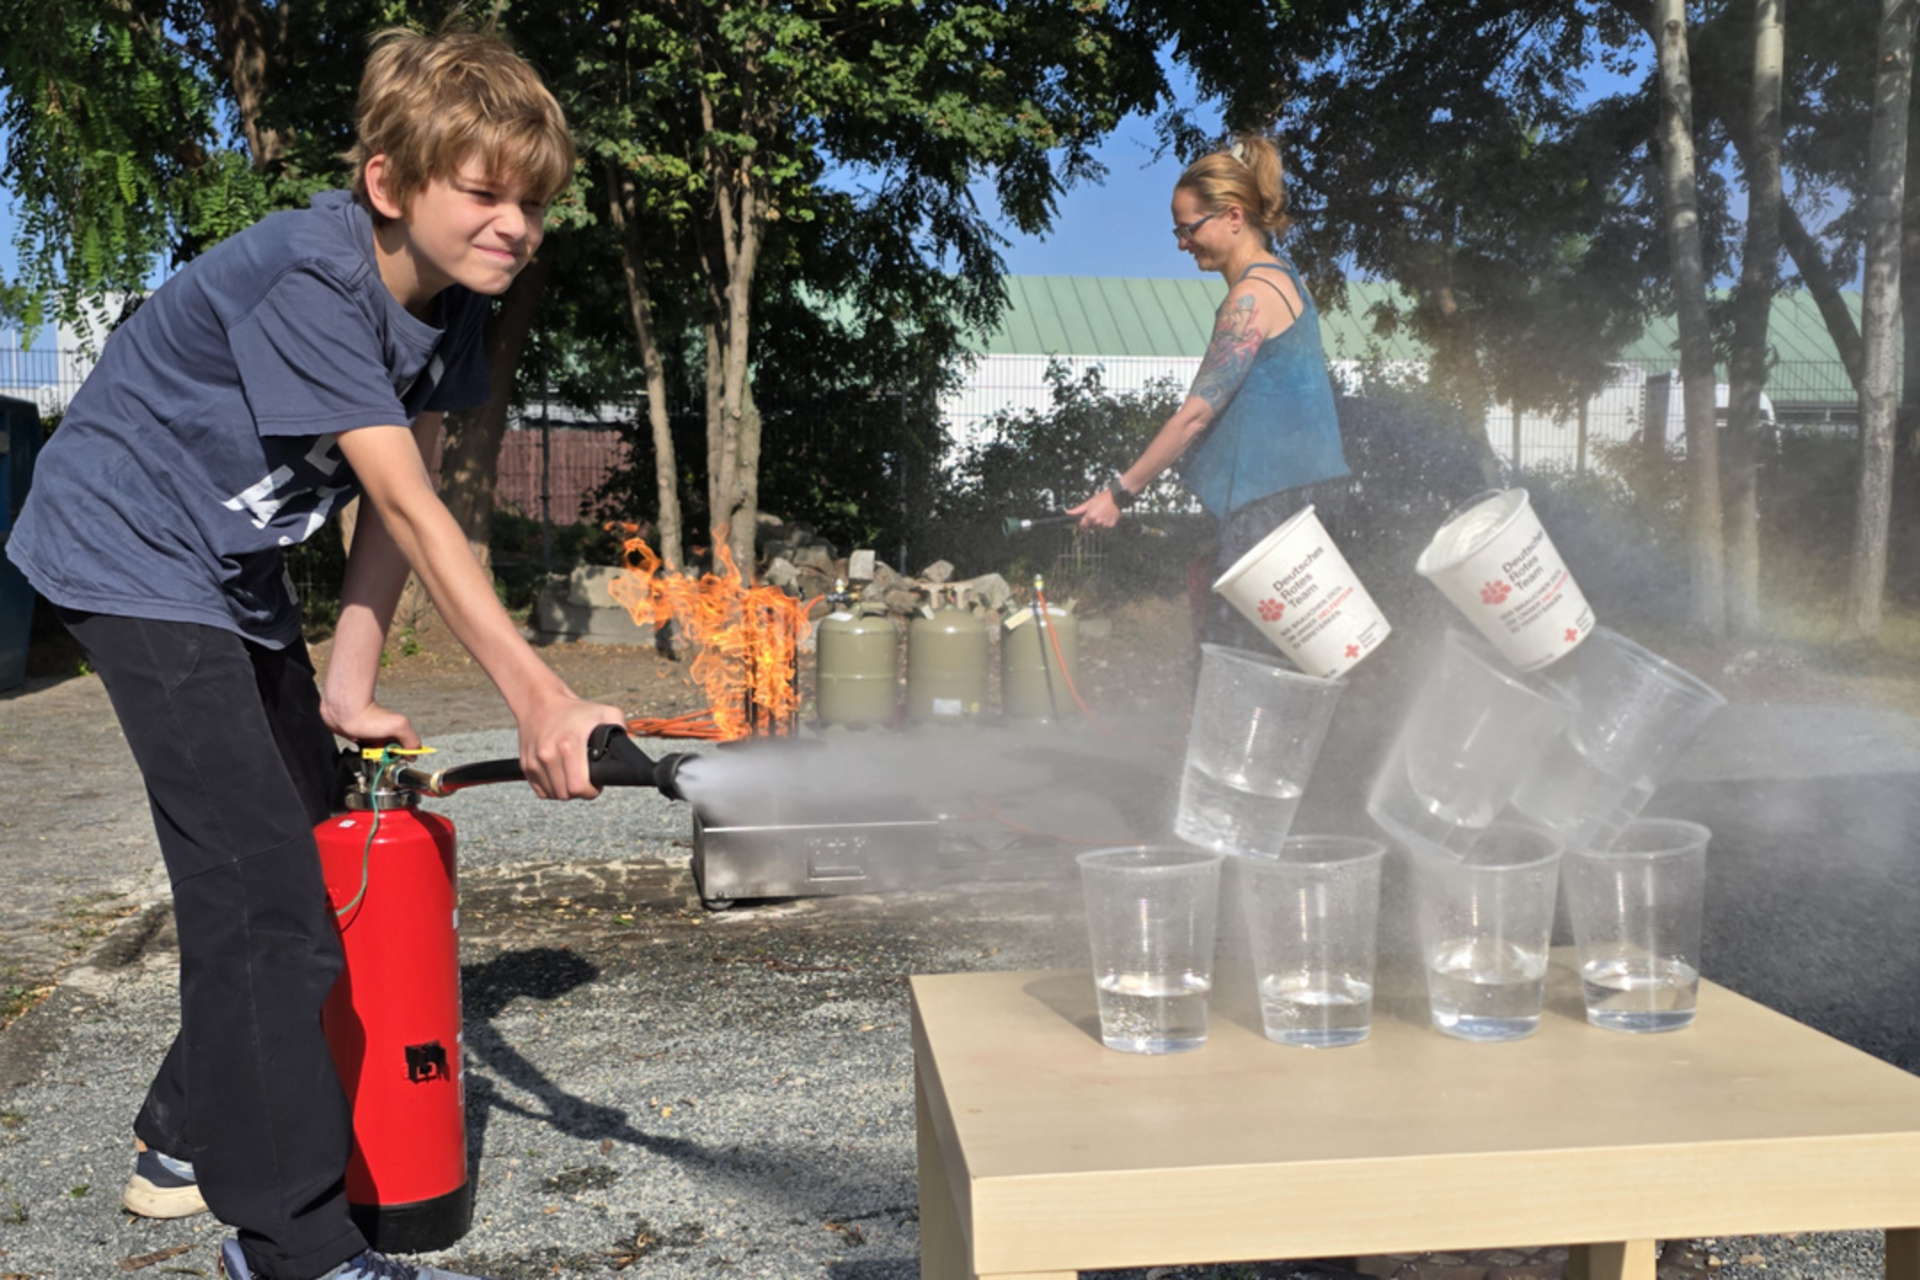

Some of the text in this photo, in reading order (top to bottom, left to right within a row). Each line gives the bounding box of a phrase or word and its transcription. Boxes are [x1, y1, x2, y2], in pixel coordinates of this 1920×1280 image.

[1273, 547, 1323, 591] Deutsches
[1509, 556, 1539, 582] Rotes
[1516, 566, 1544, 591] Team
[1280, 573, 1313, 600] Rotes
[1288, 583, 1318, 608] Team
